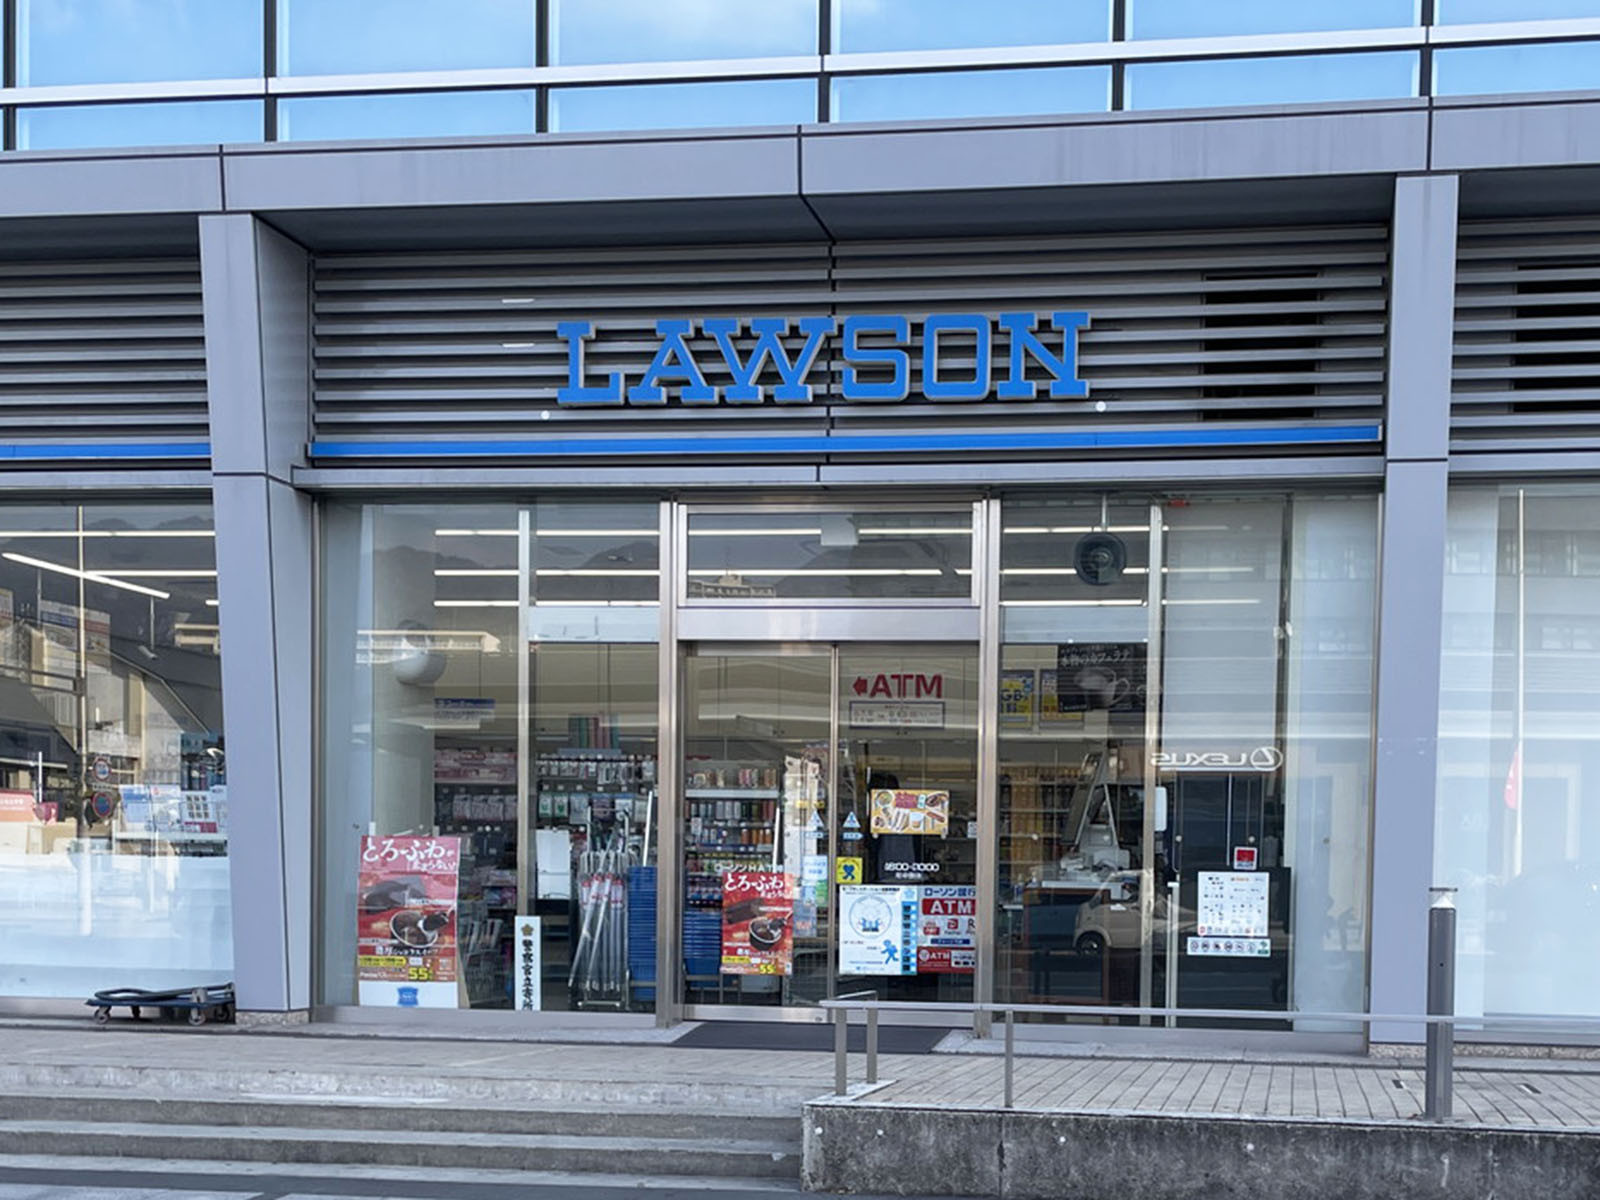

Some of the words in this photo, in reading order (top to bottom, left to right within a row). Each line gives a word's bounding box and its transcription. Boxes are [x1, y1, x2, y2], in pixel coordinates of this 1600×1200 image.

[556, 311, 1092, 406] LAWSON
[869, 673, 943, 699] ATM
[930, 899, 972, 914] ATM
